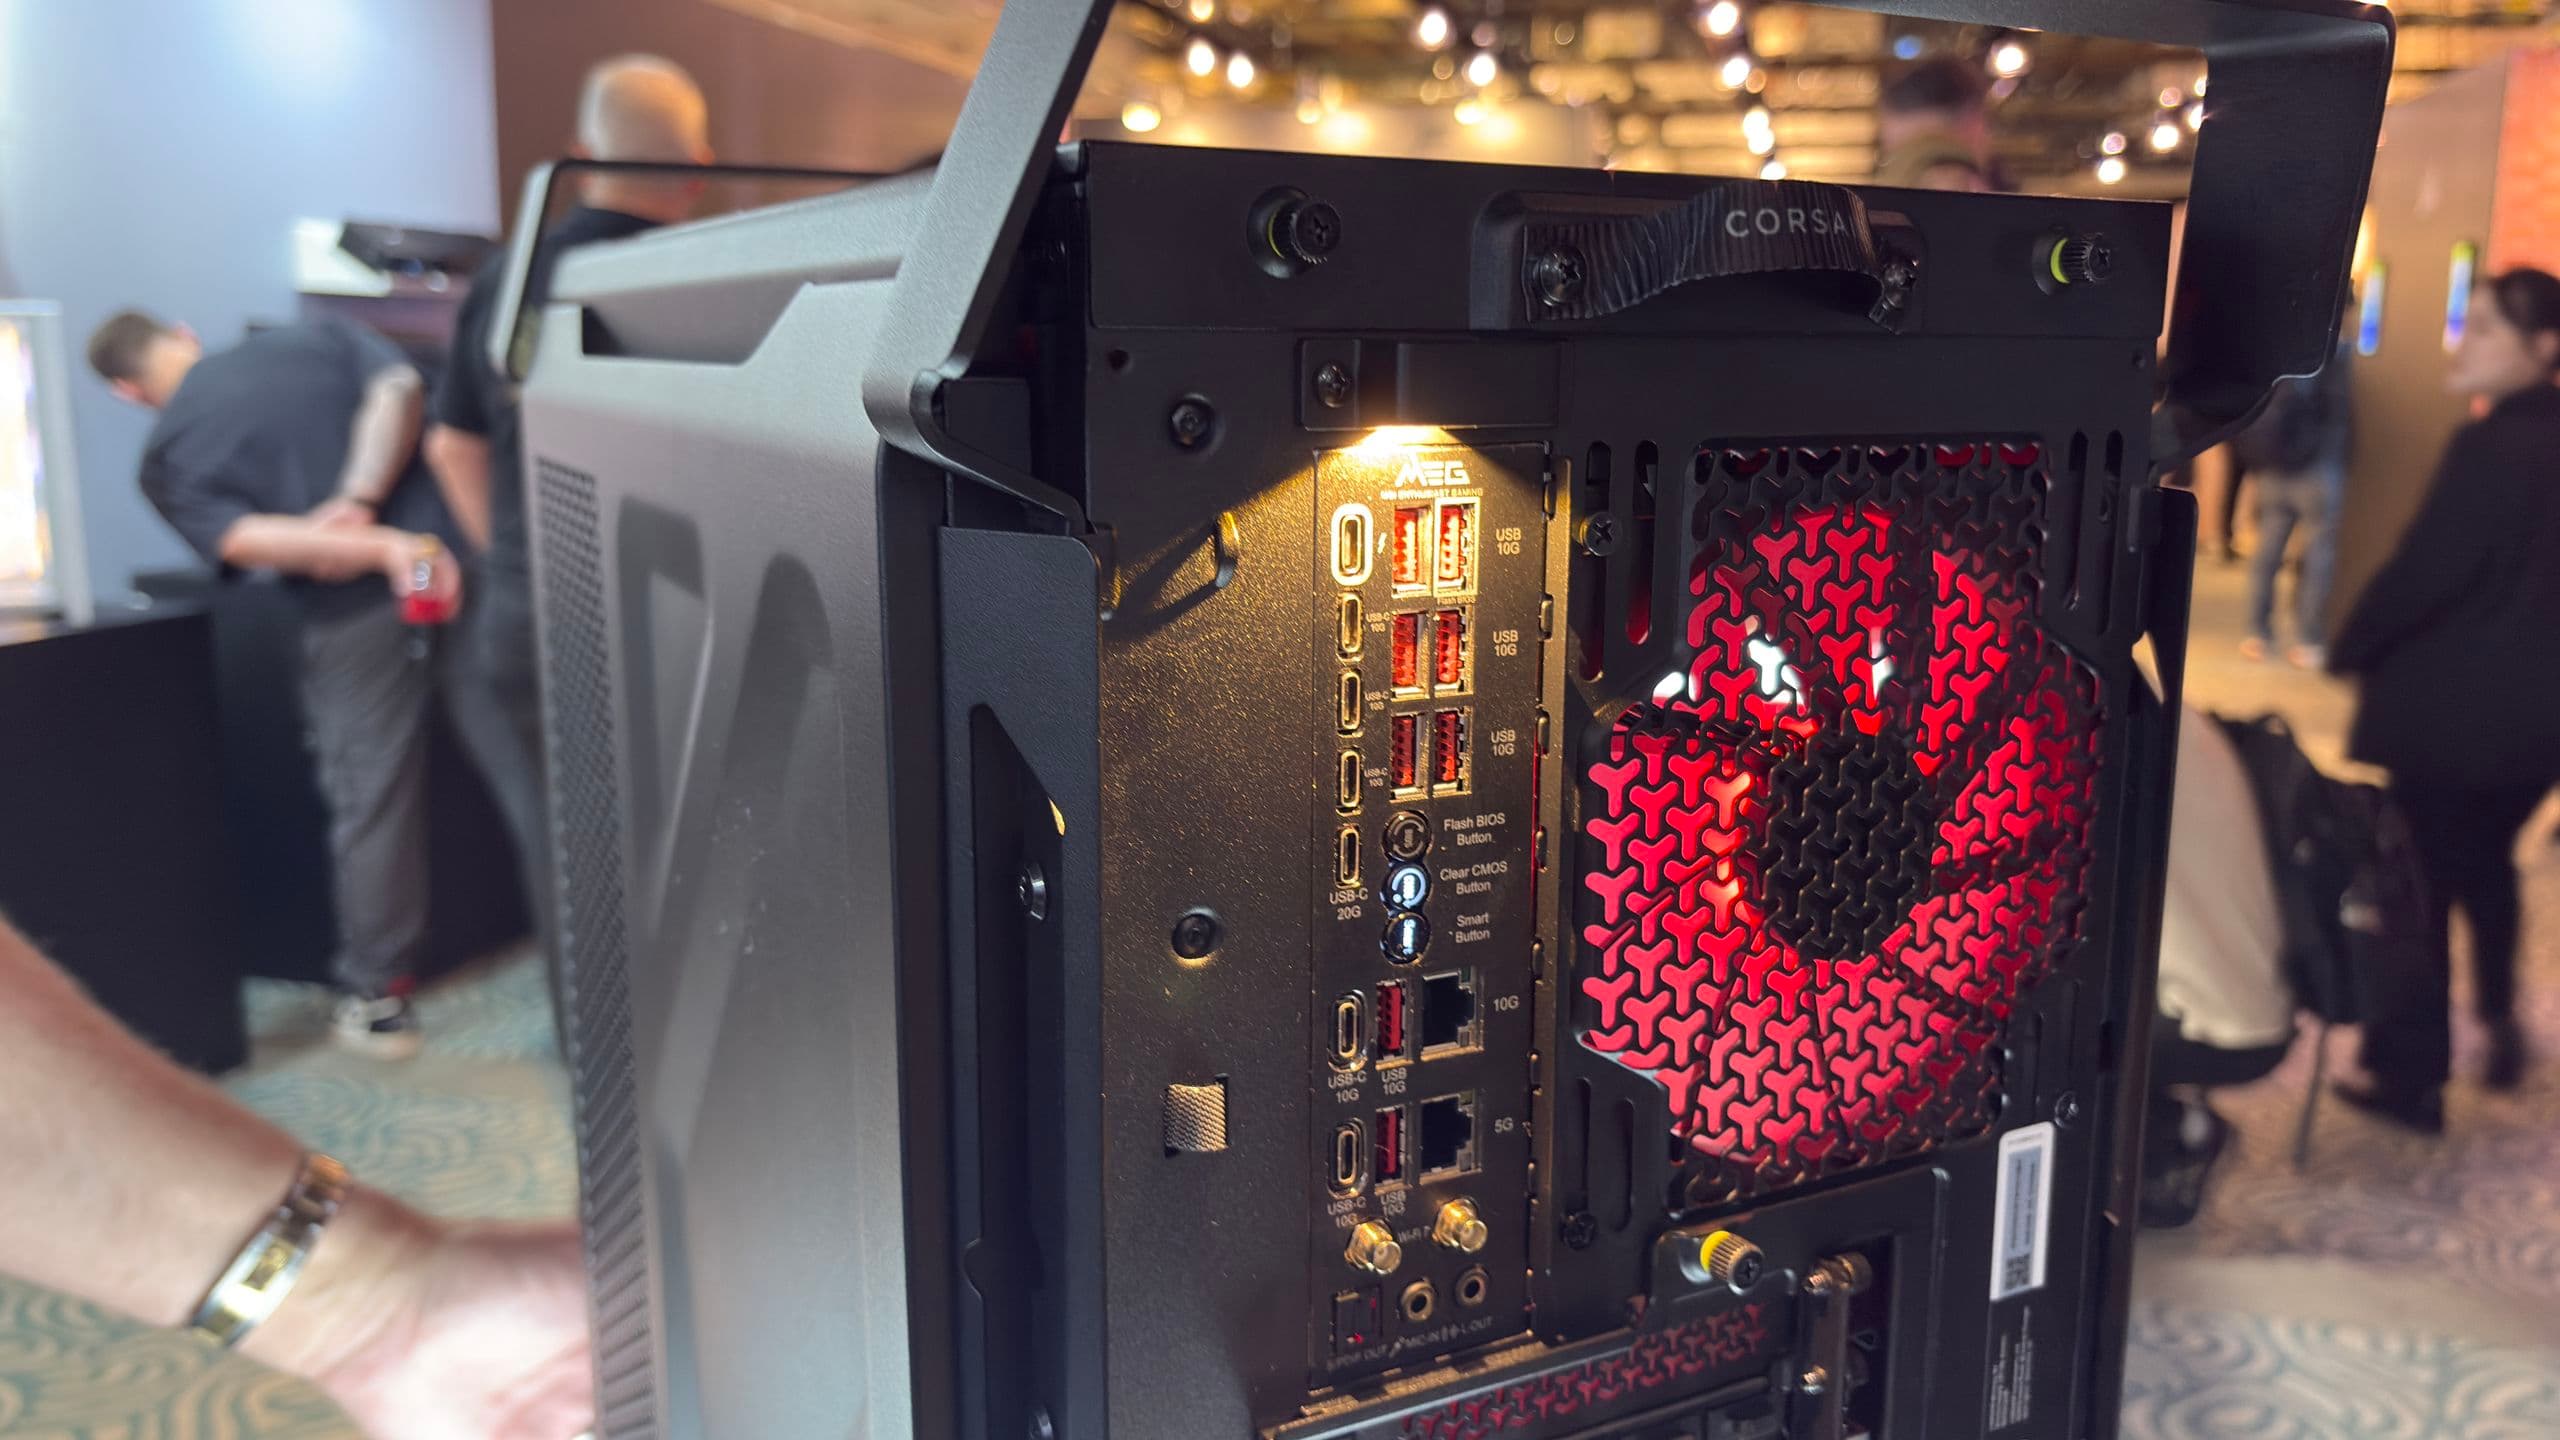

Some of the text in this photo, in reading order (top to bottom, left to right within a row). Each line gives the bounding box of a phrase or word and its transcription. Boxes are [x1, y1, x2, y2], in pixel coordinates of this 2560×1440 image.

[1395, 453, 1470, 487] MEG
[1496, 528, 1521, 542] USB
[1497, 542, 1520, 555] 10G
[1366, 613, 1390, 624] USB-C
[1370, 623, 1386, 632] 10G
[1493, 630, 1519, 644] USB
[1494, 644, 1517, 656] 10G
[1365, 692, 1389, 702] USB-C
[1369, 701, 1385, 711] 10G
[1491, 730, 1516, 744] USB
[1492, 743, 1514, 756] 10G
[1363, 768, 1389, 778] USB-C
[1443, 813, 1506, 832] Flash BIOS
[1456, 832, 1492, 847] Button
[1440, 861, 1508, 881] Clear CMOS
[1456, 880, 1492, 895] Button
[1329, 888, 1368, 905] USB-C
[1337, 907, 1361, 920] 20G
[1456, 912, 1490, 927] Smart
[1455, 929, 1490, 944] Button
[1494, 995, 1519, 1012] 10G
[1328, 1070, 1367, 1089] USB-C
[1381, 1068, 1407, 1083] USB
[1383, 1081, 1406, 1095] 10G
[1335, 1088, 1359, 1104] 10G
[1494, 1117, 1514, 1133] 5G
[1380, 1191, 1406, 1205] USB
[1327, 1196, 1366, 1216] USB-C
[1382, 1202, 1405, 1217] 10G
[1335, 1213, 1358, 1228] 10G
